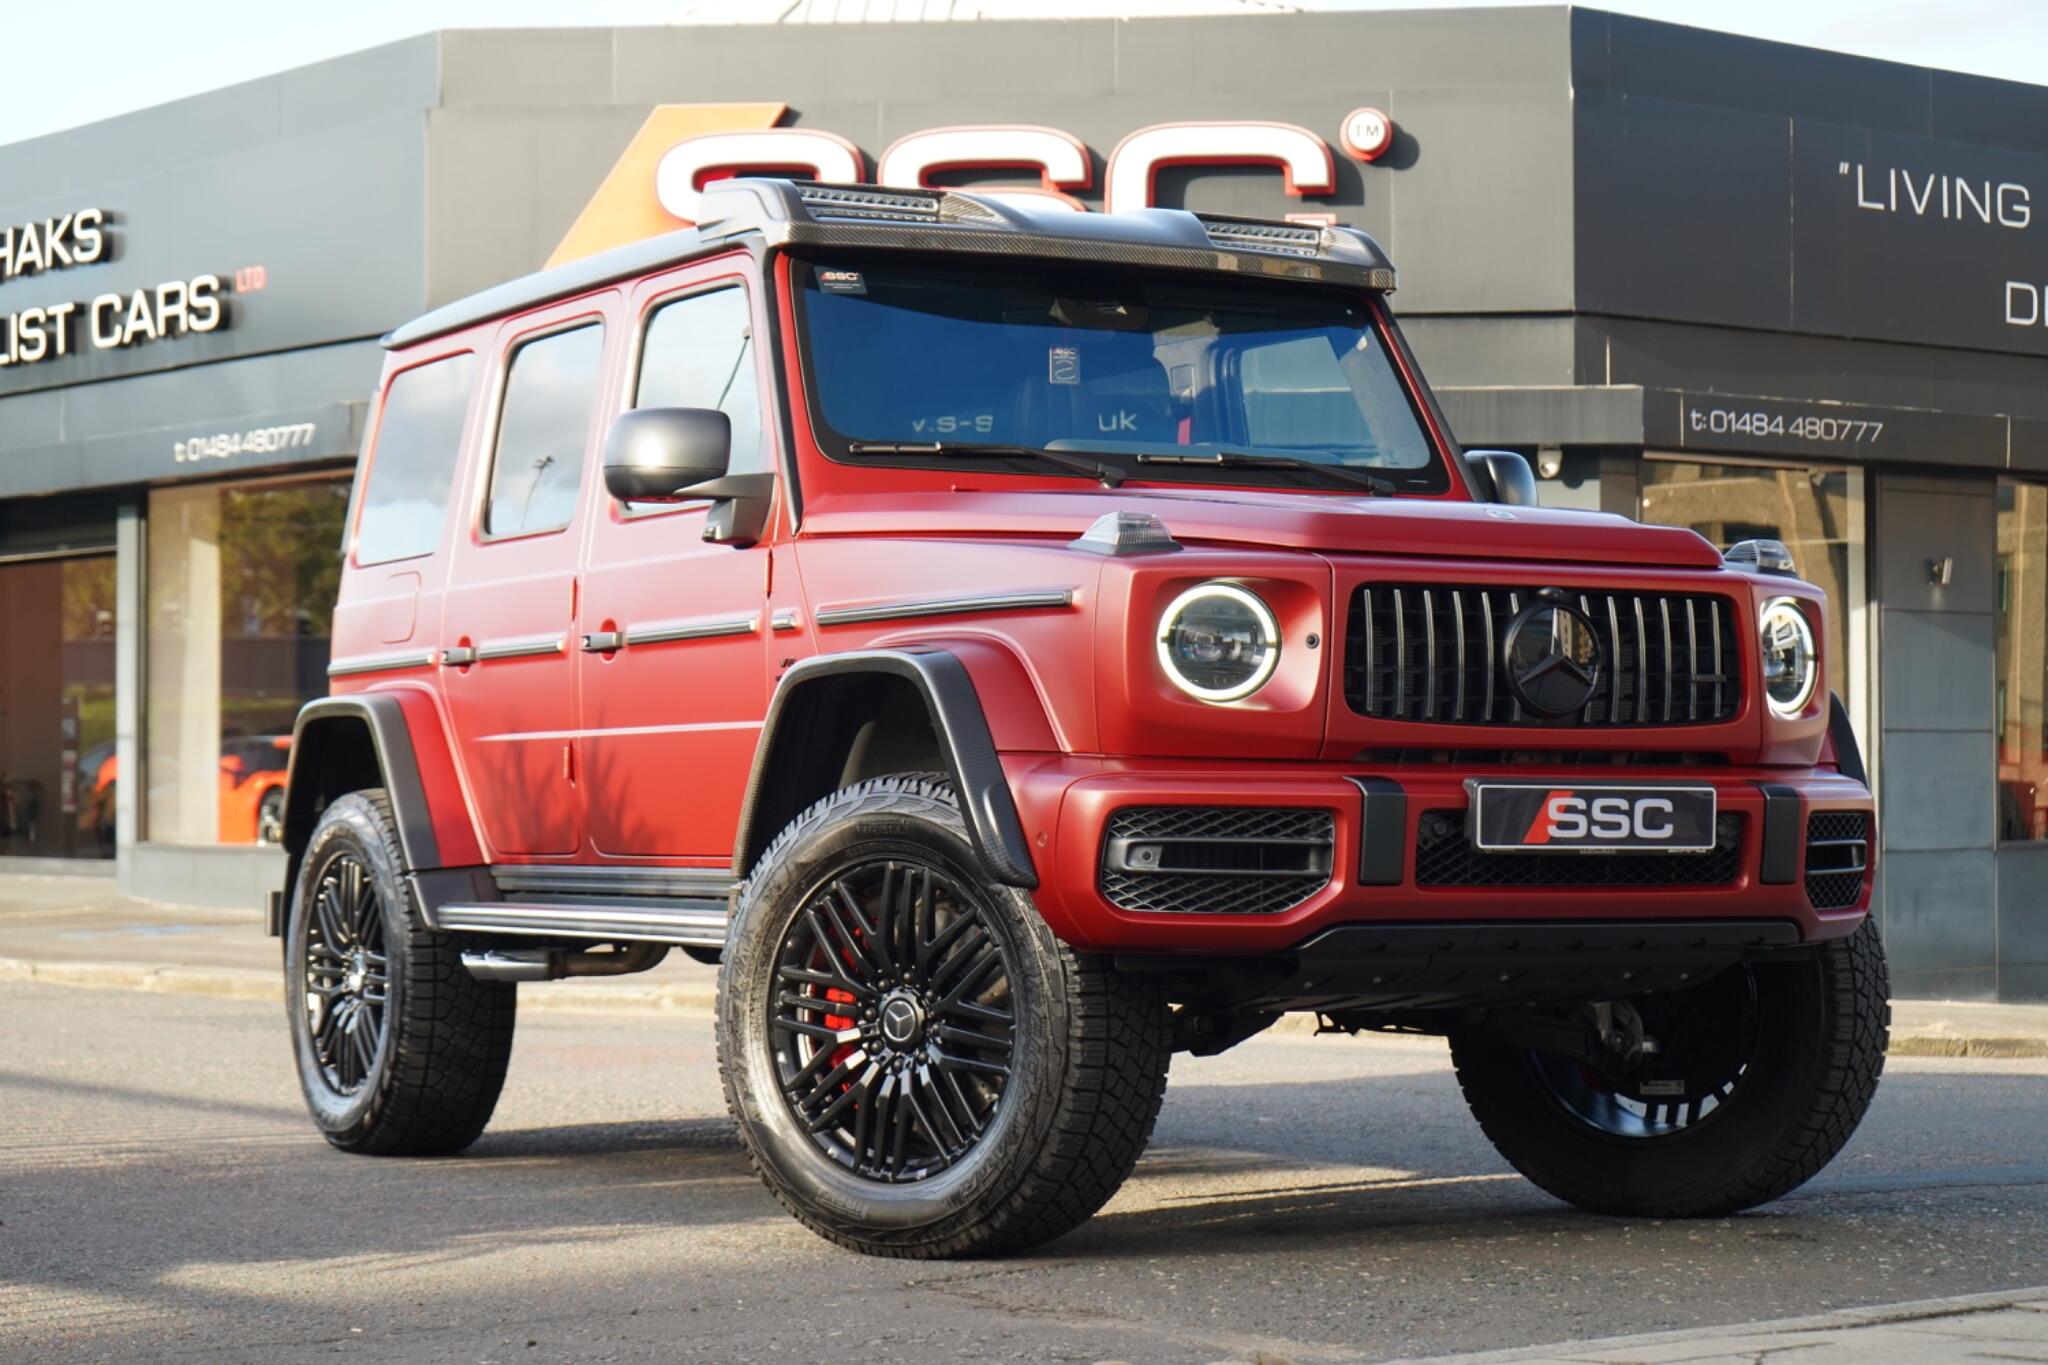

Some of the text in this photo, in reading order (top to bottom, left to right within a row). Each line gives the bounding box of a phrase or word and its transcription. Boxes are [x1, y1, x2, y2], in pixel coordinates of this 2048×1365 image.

[1355, 123, 1380, 138] TM
[91, 274, 220, 349] CARS
[235, 265, 267, 293] LTD
[1098, 410, 1138, 432] uk
[1788, 416, 1884, 443] 480777
[242, 422, 316, 453] 480777
[1546, 796, 1674, 839] SSC
